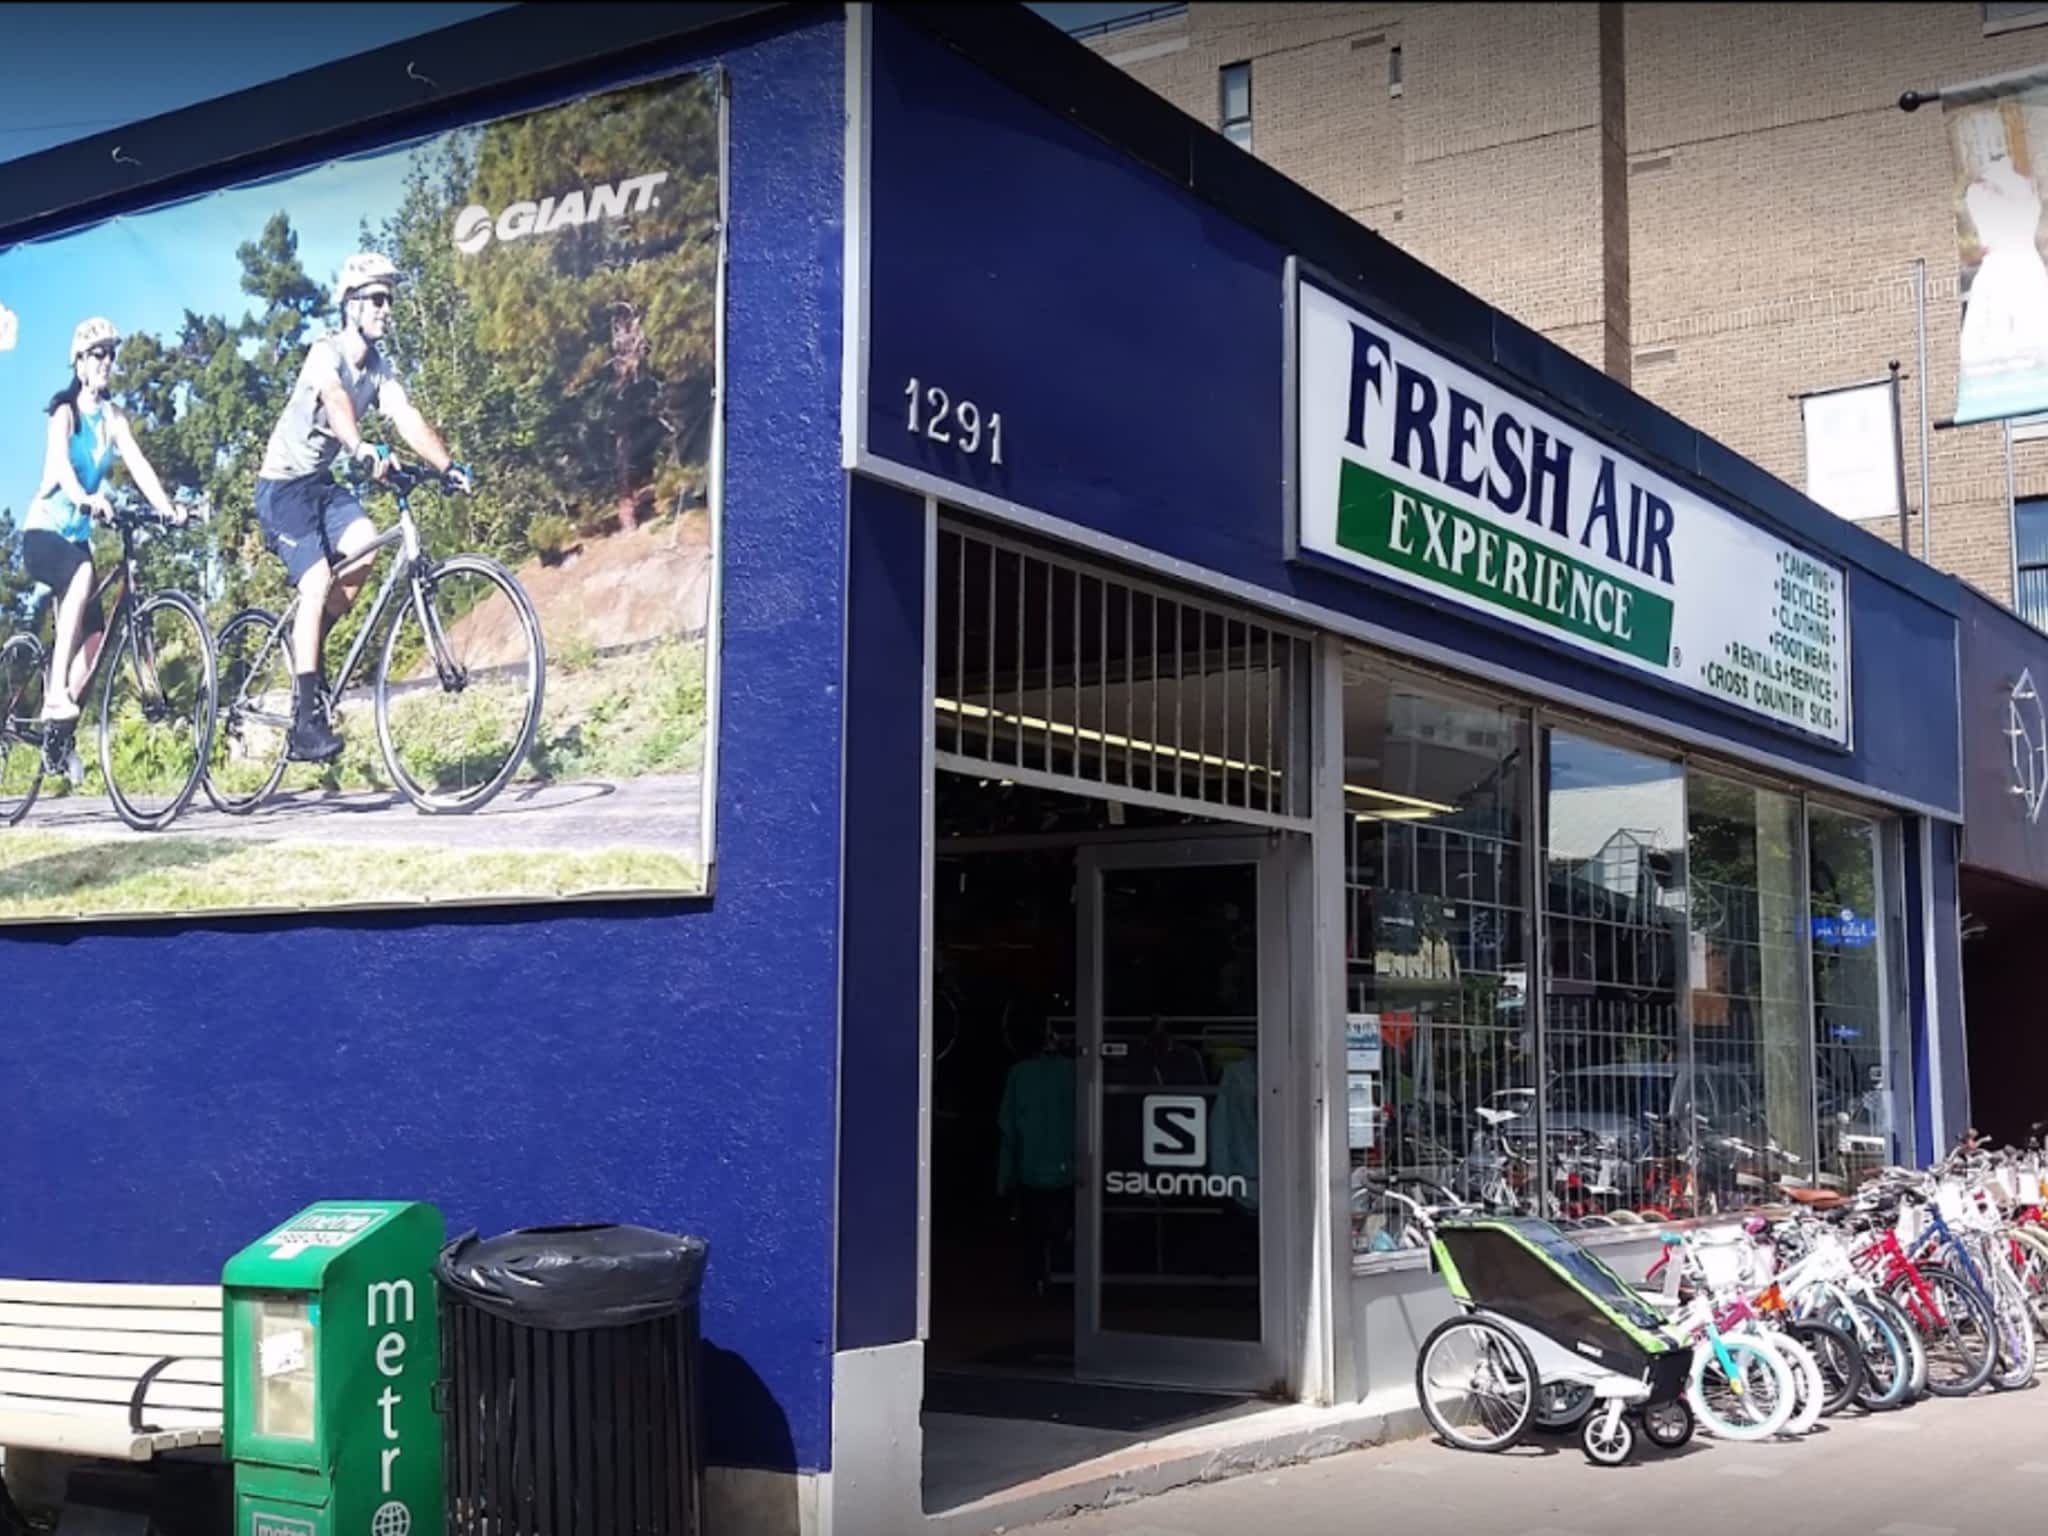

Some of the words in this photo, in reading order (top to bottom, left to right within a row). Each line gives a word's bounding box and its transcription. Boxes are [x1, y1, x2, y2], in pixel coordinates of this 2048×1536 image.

[905, 377, 1002, 464] 1291
[1344, 320, 1574, 539] FRESH
[1580, 454, 1675, 585] AIR
[1388, 490, 1634, 641] EXPERIENCE
[1783, 551, 1829, 592] CAMPING
[1779, 605, 1830, 647] CLOTHING
[1781, 577, 1829, 620] BICYCLES
[1774, 632, 1830, 674] FOOTWEAR
[1707, 661, 1749, 699] CROSS
[1754, 680, 1805, 720] COUNTRY
[1810, 701, 1832, 729] SKIS
